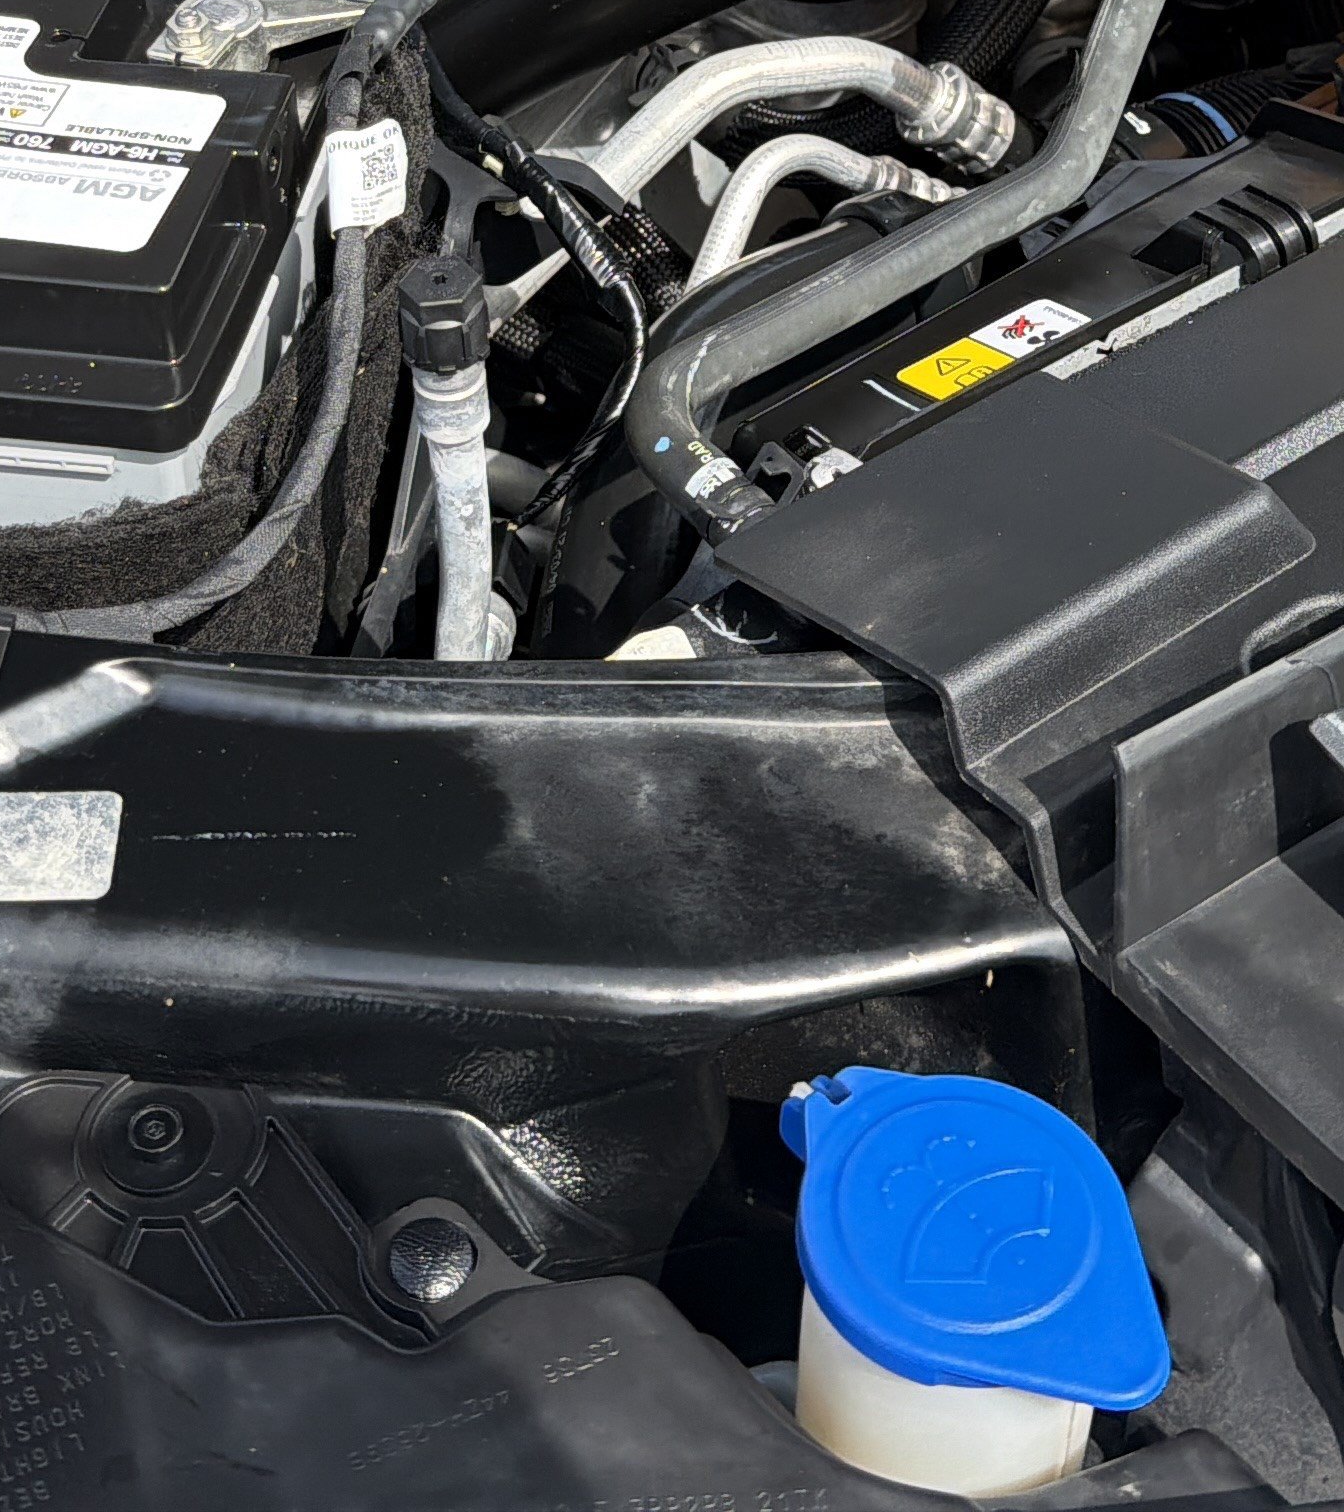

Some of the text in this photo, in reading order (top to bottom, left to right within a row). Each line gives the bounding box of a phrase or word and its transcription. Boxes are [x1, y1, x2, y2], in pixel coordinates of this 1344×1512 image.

[11, 133, 55, 150] 760
[64, 124, 192, 145] NON-SPILLABLE
[69, 139, 158, 161] H6-AGM
[73, 179, 166, 202] AGM
[687, 440, 714, 464] RAD
[3, 1308, 75, 1352] HORZ
